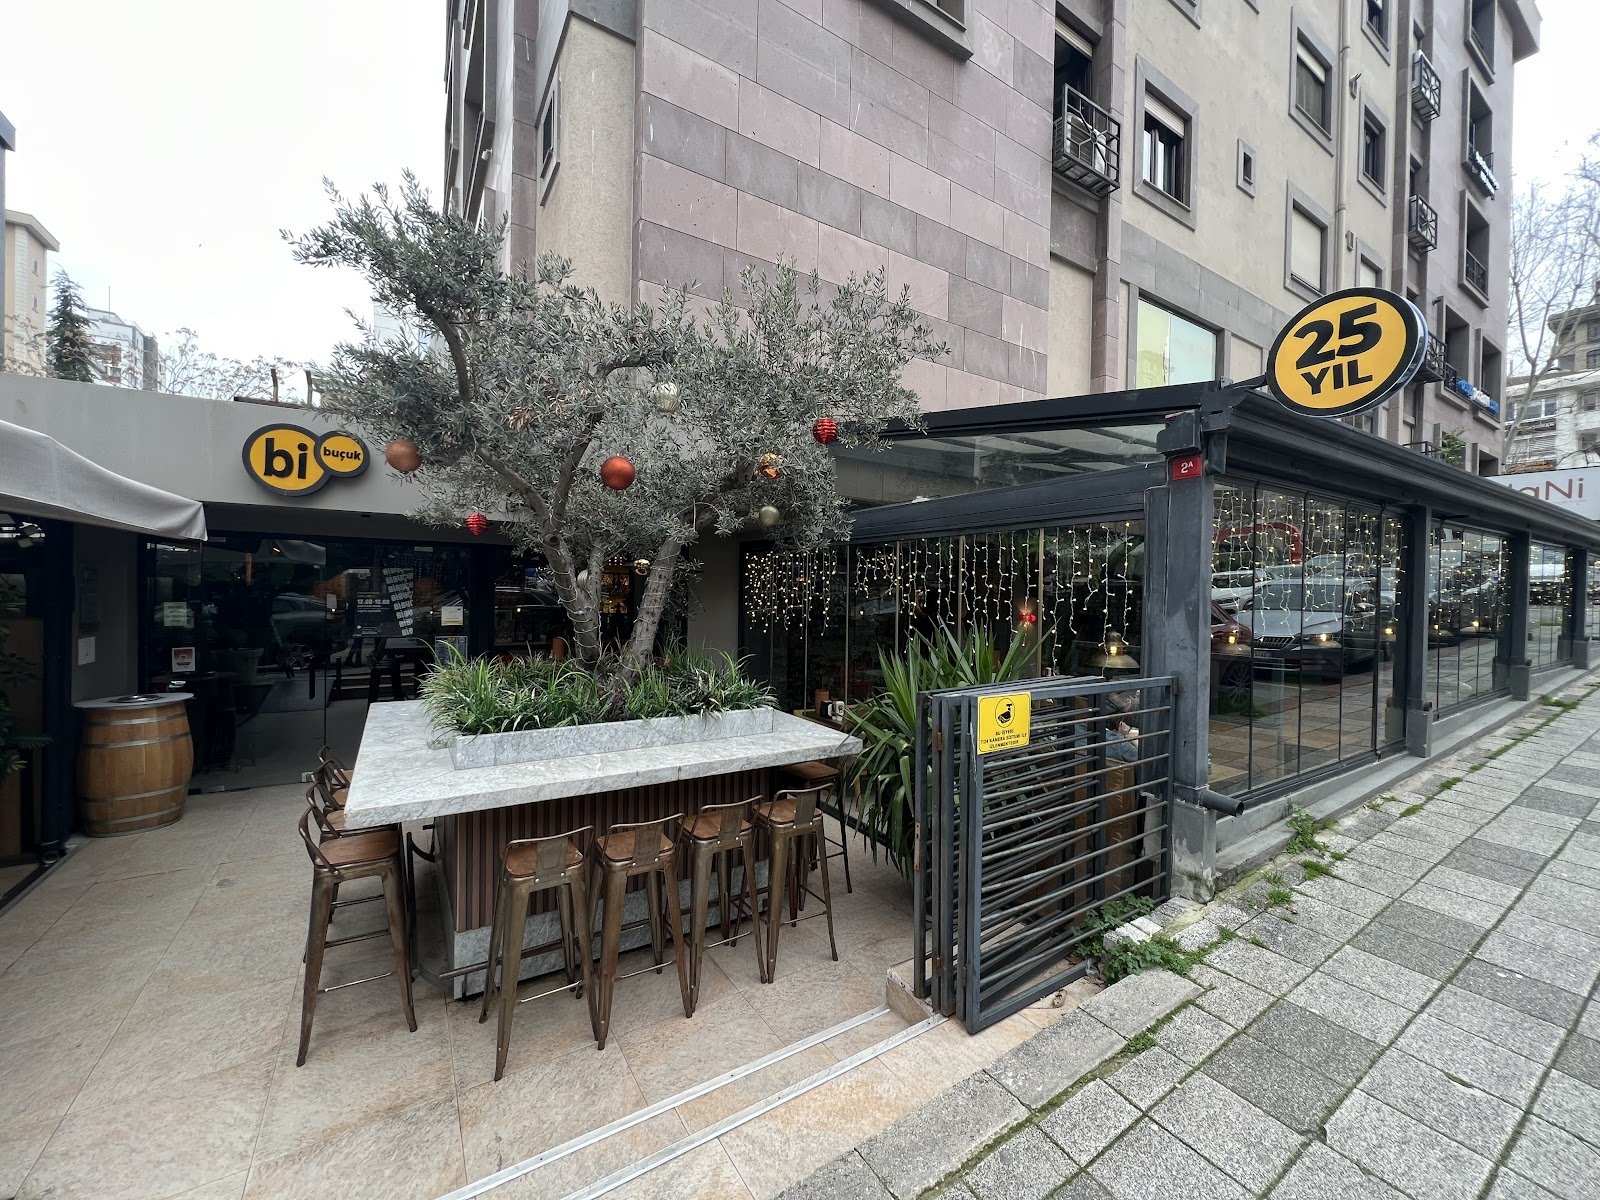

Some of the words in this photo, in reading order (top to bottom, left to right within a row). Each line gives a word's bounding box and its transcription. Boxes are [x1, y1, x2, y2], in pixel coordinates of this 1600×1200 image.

[1293, 302, 1382, 370] 25
[1300, 359, 1373, 395] YIL
[264, 437, 308, 479] bi
[323, 446, 361, 461] buçuk
